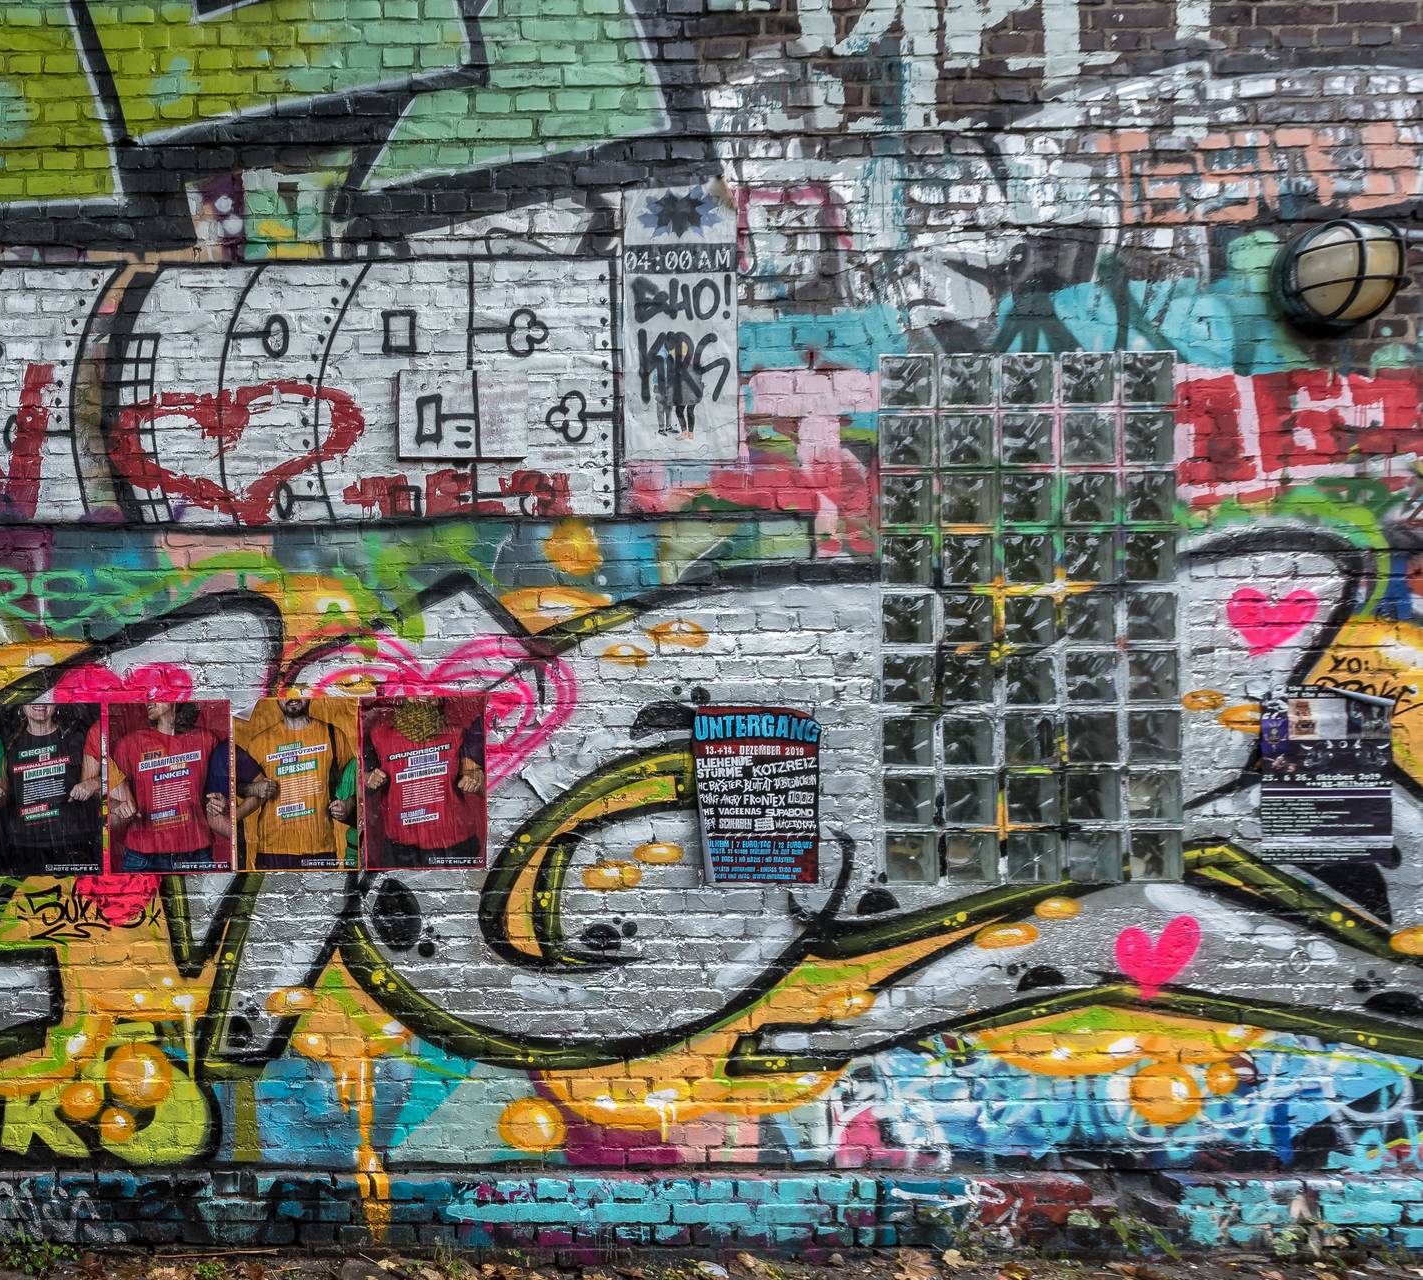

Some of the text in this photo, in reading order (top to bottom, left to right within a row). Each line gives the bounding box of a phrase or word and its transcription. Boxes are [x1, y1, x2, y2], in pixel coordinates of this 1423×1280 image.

[624, 249, 731, 271] 04:00 AM
[694, 713, 821, 742] UNTERGANG
[21, 746, 54, 758] GEGEN
[144, 751, 162, 761] EIN
[389, 744, 450, 760] GRUNDRECHTE
[739, 744, 780, 756] DEZEMBER
[784, 746, 805, 756] 2019
[140, 752, 199, 770] SOLIDARITÄTSVEREIN
[696, 756, 754, 769] FLIEHENDE
[752, 757, 817, 777] KOTZREIZ
[154, 769, 190, 782] LINKEN
[697, 767, 744, 779] STÜRME
[1295, 773, 1312, 781] 26.
[1315, 773, 1355, 781] Oktober
[1357, 773, 1382, 781] 2019
[788, 791, 815, 804] 1982
[717, 807, 762, 816] VAGEENAS
[765, 808, 814, 818] SUPABOND
